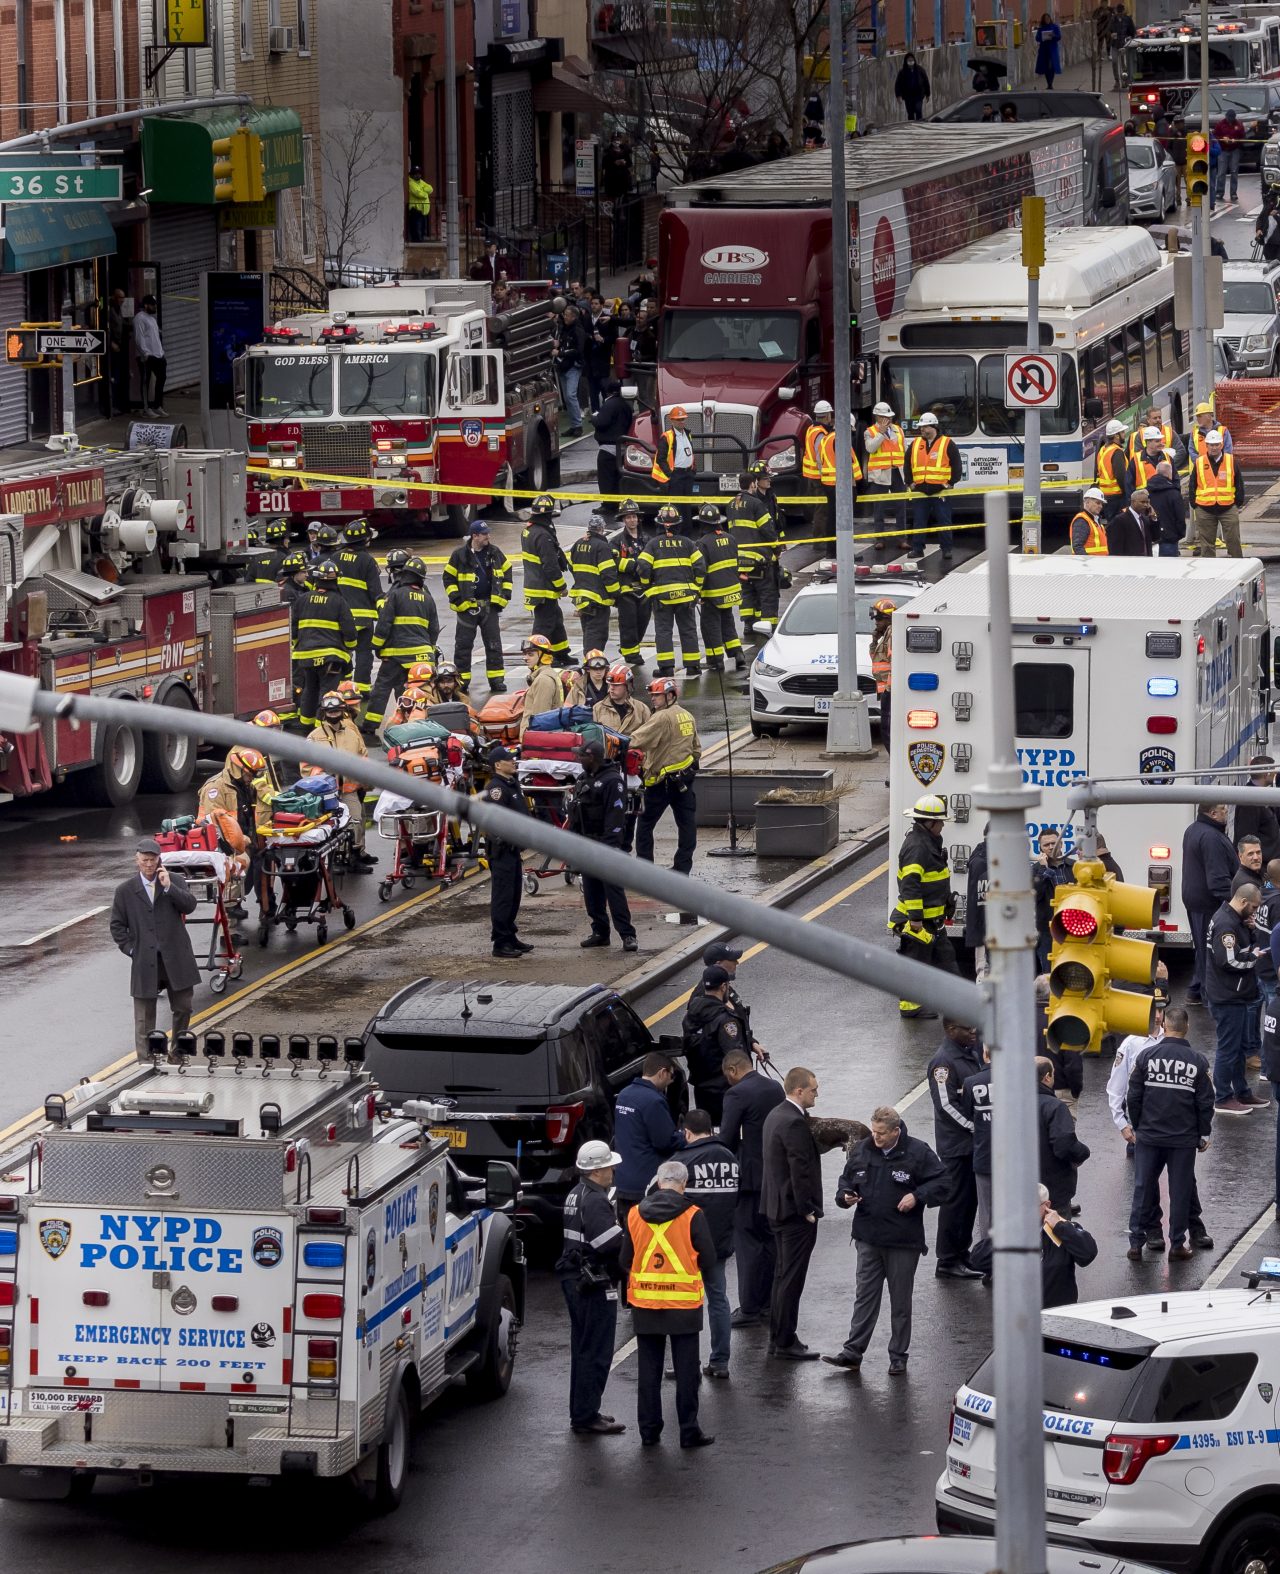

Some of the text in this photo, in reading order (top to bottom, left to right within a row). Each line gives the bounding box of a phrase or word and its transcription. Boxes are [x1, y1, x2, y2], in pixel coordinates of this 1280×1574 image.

[10, 174, 84, 196] 36 St
[711, 252, 748, 265] JBS
[704, 273, 762, 286] CARRIERS
[872, 256, 897, 285] Swift
[46, 337, 96, 348] ONE WAY
[274, 354, 390, 367] GOD BLESS AMERICA
[286, 426, 388, 435] F.D. N.Y.
[5, 489, 37, 515] LADDER
[37, 487, 52, 510] 114
[66, 482, 92, 508] TALLY
[259, 492, 293, 513] 201
[160, 640, 186, 669] FDNY
[1141, 748, 1175, 762] POLICE
[1149, 758, 1166, 767] NYPD
[1147, 1058, 1198, 1080] NYPD
[1147, 1073, 1195, 1088] POLICE
[693, 1163, 740, 1180] NYPD
[383, 1185, 418, 1245] POLICE
[99, 1214, 223, 1244] NYPD
[254, 1228, 281, 1241] POLICE
[79, 1243, 243, 1274] POLICE
[449, 1245, 475, 1305] NYPD
[640, 1282, 677, 1291] NYC Transit
[74, 1323, 247, 1349] EMERGENCY SERVICE
[57, 1353, 267, 1371] KEEP BACK 200 FEET
[31, 1392, 104, 1404] $10,000 REWARD
[963, 1393, 993, 1414] NYPD
[1192, 1430, 1266, 1449] 4395 ESU K-9
